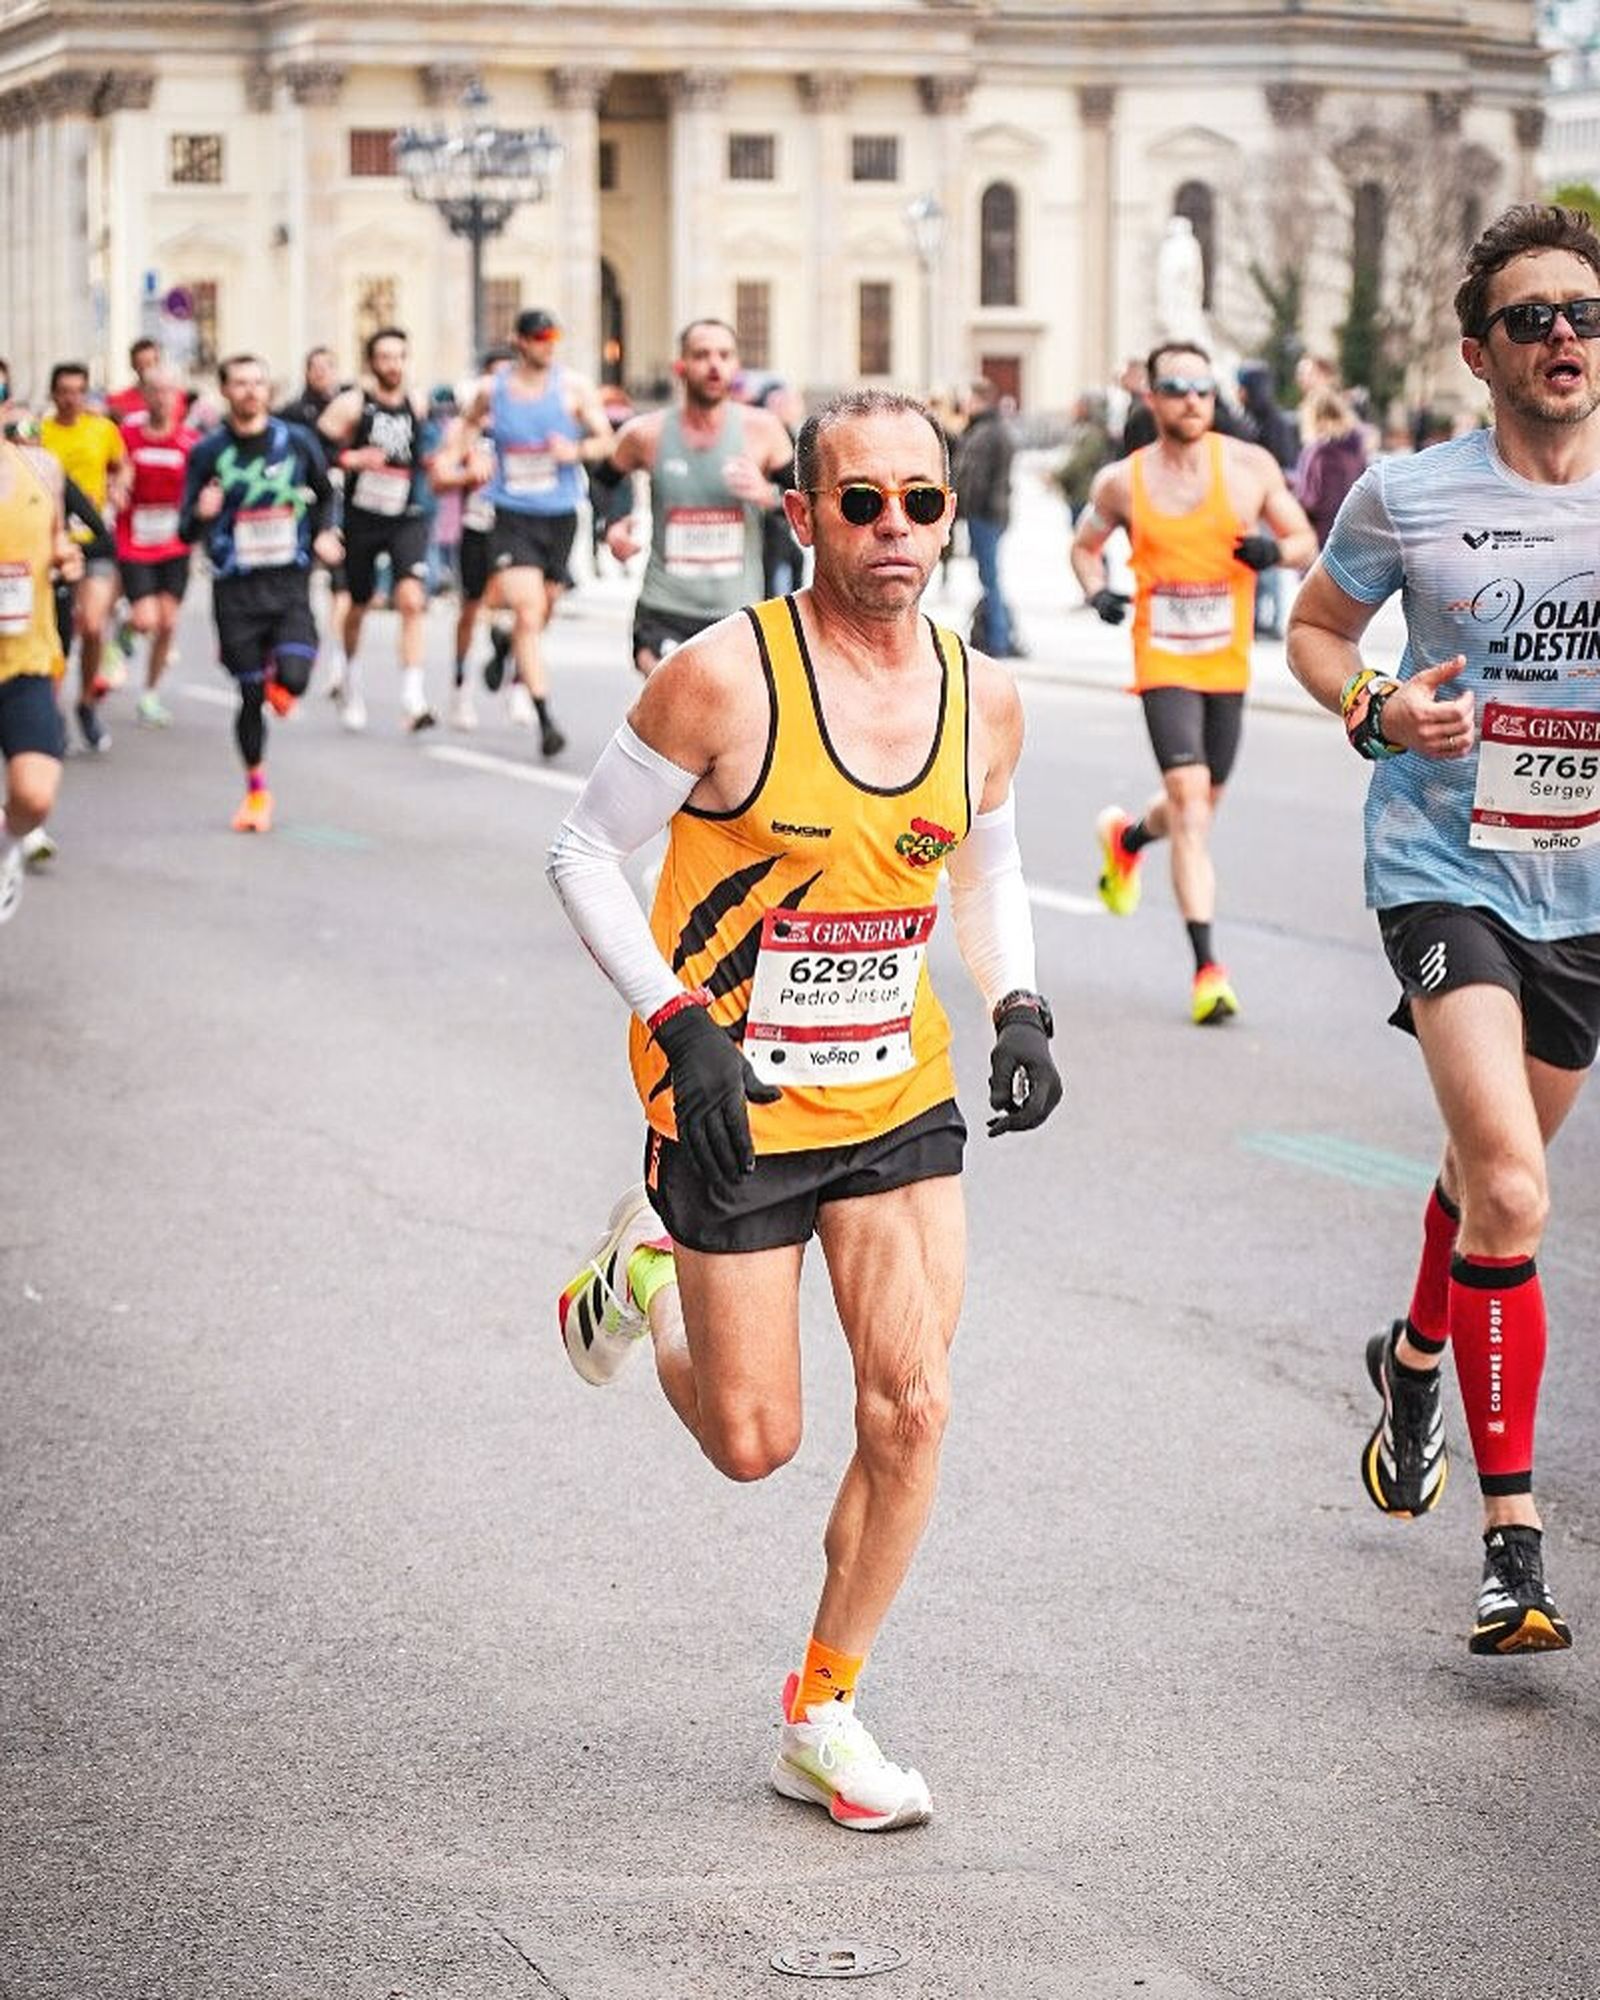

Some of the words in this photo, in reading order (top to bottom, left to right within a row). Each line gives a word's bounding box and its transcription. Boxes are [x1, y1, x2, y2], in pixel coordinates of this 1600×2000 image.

[1489, 638, 1509, 654] mi
[1505, 669, 1559, 682] VALENCIA
[1513, 753, 1599, 780] 2765
[1529, 781, 1595, 801] Sergey
[1531, 837, 1581, 850] YoPRO
[790, 954, 899, 985] 62926
[780, 987, 841, 1006] Pedro
[809, 1050, 860, 1066] YoPRO
